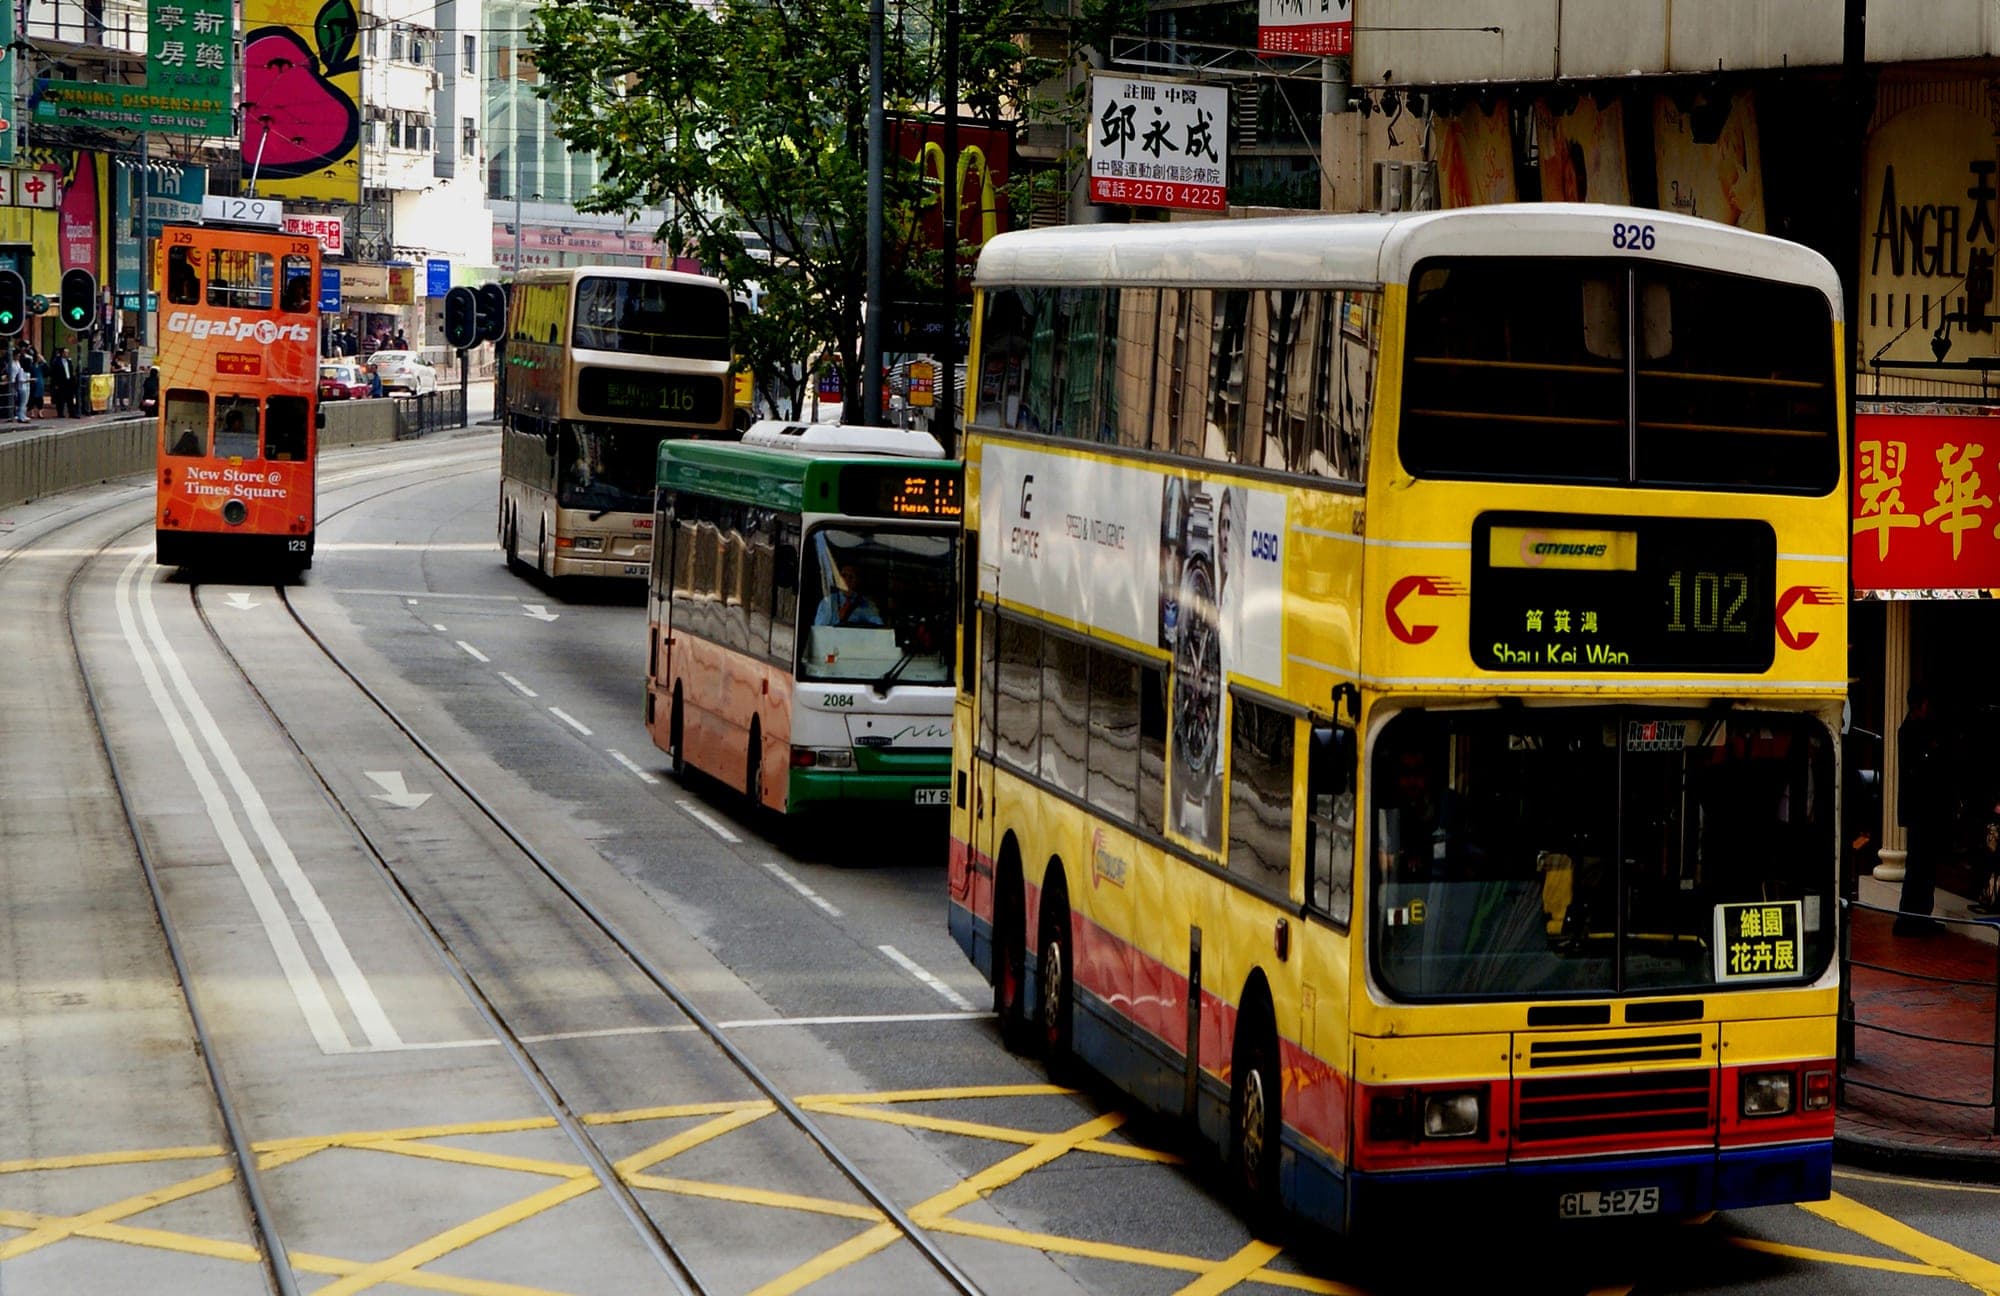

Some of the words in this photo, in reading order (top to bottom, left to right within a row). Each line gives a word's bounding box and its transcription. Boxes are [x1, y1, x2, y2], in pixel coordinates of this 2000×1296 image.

[122, 94, 223, 113] DISPENSARY
[150, 114, 208, 129] SERVICE
[1100, 99, 1219, 164] 邱永成
[1096, 159, 1221, 184] 中醫運動創傷診療院
[1181, 187, 1221, 206] 4225
[222, 199, 266, 221] 129
[1872, 164, 1966, 278] ANGEL
[173, 232, 193, 244] 129
[291, 242, 310, 254] 129
[1612, 223, 1656, 251] 826
[168, 311, 311, 345] GigaSports
[659, 387, 695, 411] 116
[187, 467, 220, 480] New
[223, 469, 265, 482] Store
[268, 472, 282, 485] @
[184, 482, 231, 496] Times
[233, 484, 287, 499] Square
[1853, 440, 2000, 563] 翠華
[288, 540, 307, 551] 129
[1251, 529, 1278, 562] CASIO
[1667, 571, 1748, 632] 102
[1493, 643, 1539, 664] Shau
[1547, 643, 1577, 664] Kei
[1586, 644, 1629, 665] Wan
[823, 694, 854, 707] 2084
[918, 791, 936, 802] HY
[1739, 906, 1785, 939] 維園
[1730, 939, 1795, 974] 花卉展
[1563, 1193, 1592, 1216] GL
[1598, 1188, 1657, 1214] 5275
